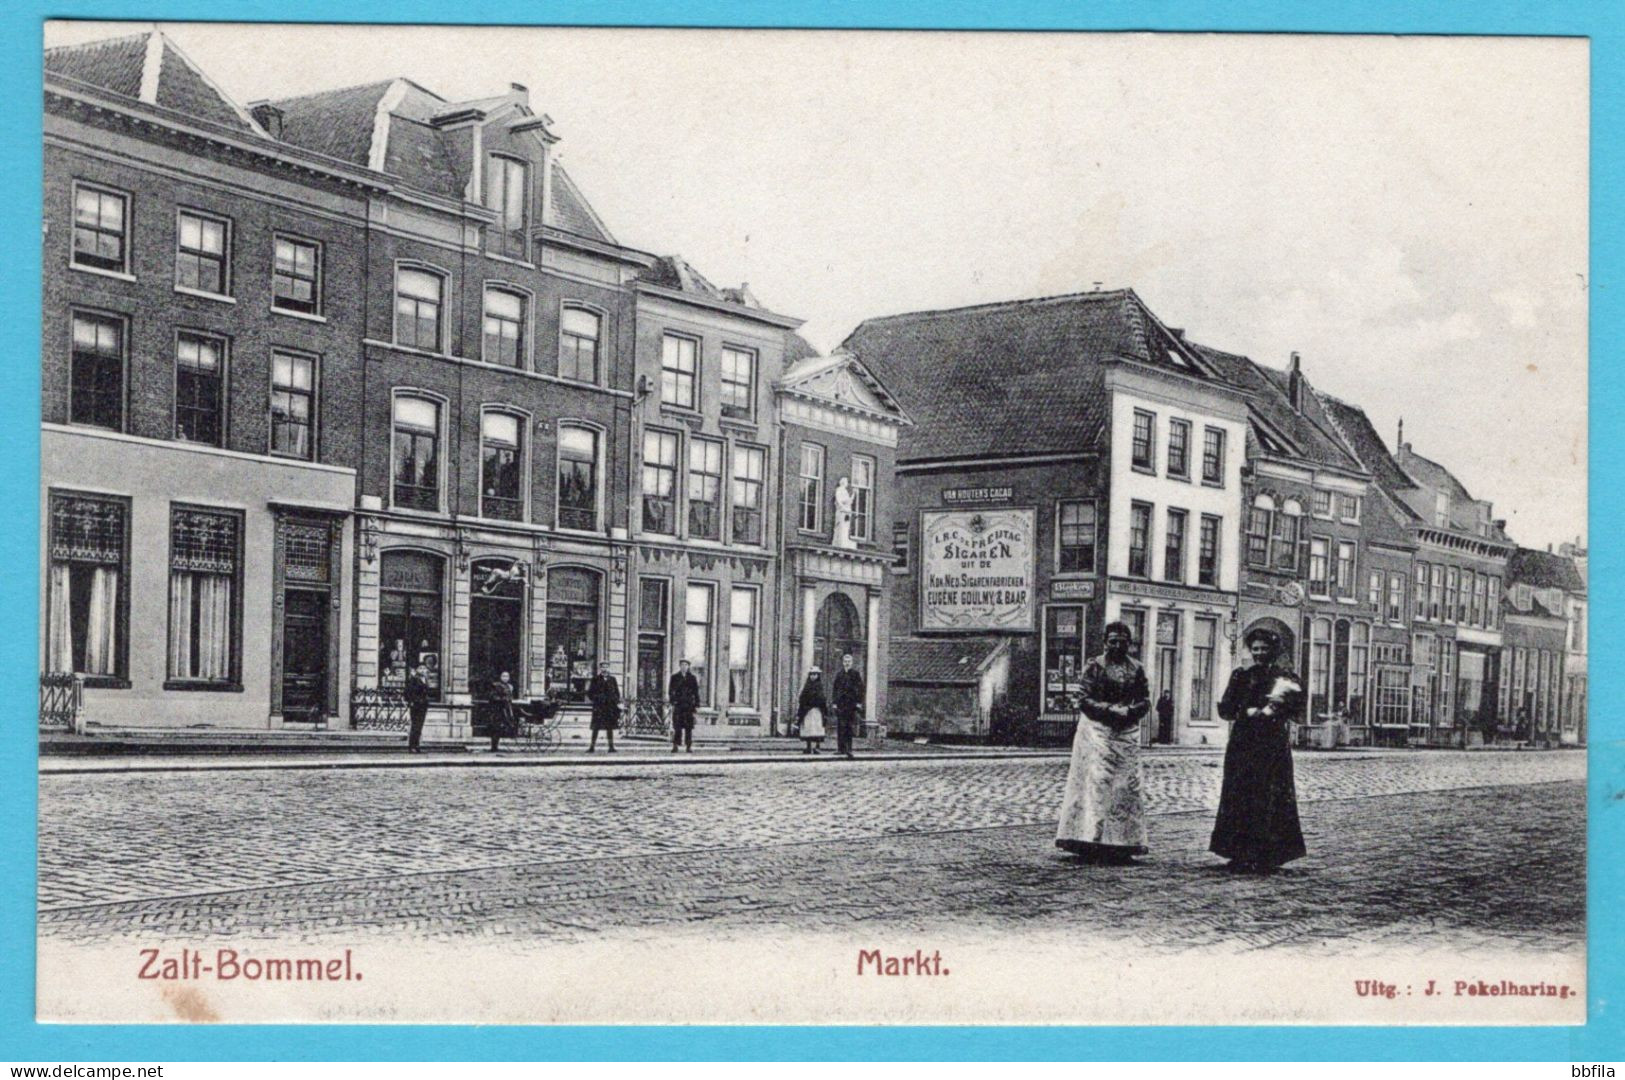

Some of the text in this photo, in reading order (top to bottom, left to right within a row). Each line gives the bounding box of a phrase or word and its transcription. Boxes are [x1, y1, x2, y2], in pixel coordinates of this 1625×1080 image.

[944, 490, 956, 500] VAN
[990, 488, 1013, 498] CACAO
[943, 542, 1012, 559] SIGAREN
[961, 561, 991, 569] UIT DE
[995, 590, 1004, 605] &
[1004, 590, 1027, 605] BAAR
